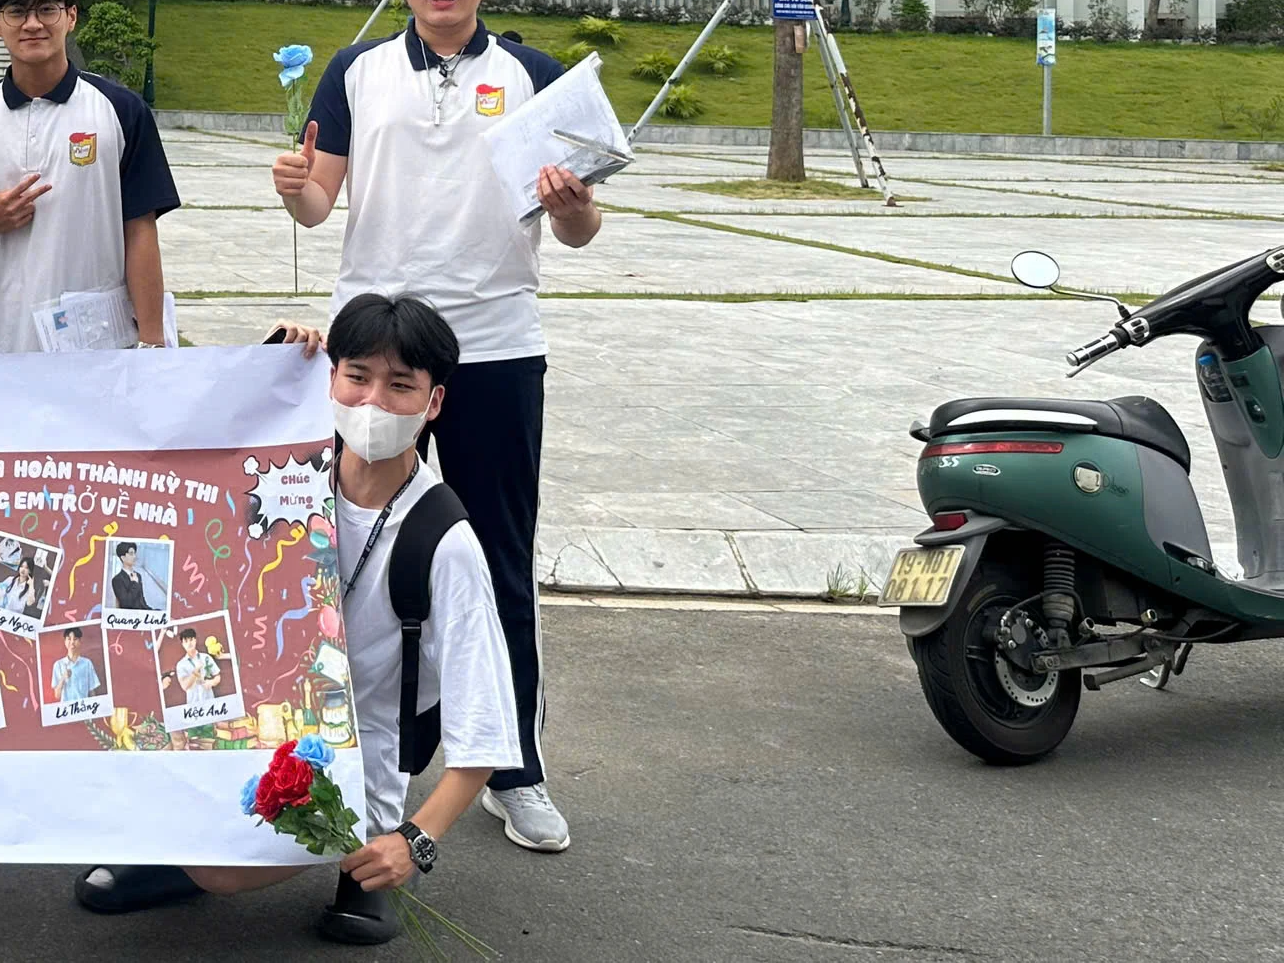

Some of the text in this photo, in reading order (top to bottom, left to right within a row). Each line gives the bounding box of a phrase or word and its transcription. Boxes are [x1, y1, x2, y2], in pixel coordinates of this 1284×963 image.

[14, 455, 72, 479] HOÀN
[76, 460, 148, 489] THÀNH
[151, 470, 181, 495] KỲ
[184, 479, 219, 504] THI
[15, 491, 45, 510] EM
[49, 485, 98, 514] TRỞ
[100, 488, 131, 517] VỀ
[133, 502, 178, 527] NHÀ
[107, 613, 168, 629] Quang Linh
[206, 703, 228, 717] Anh
